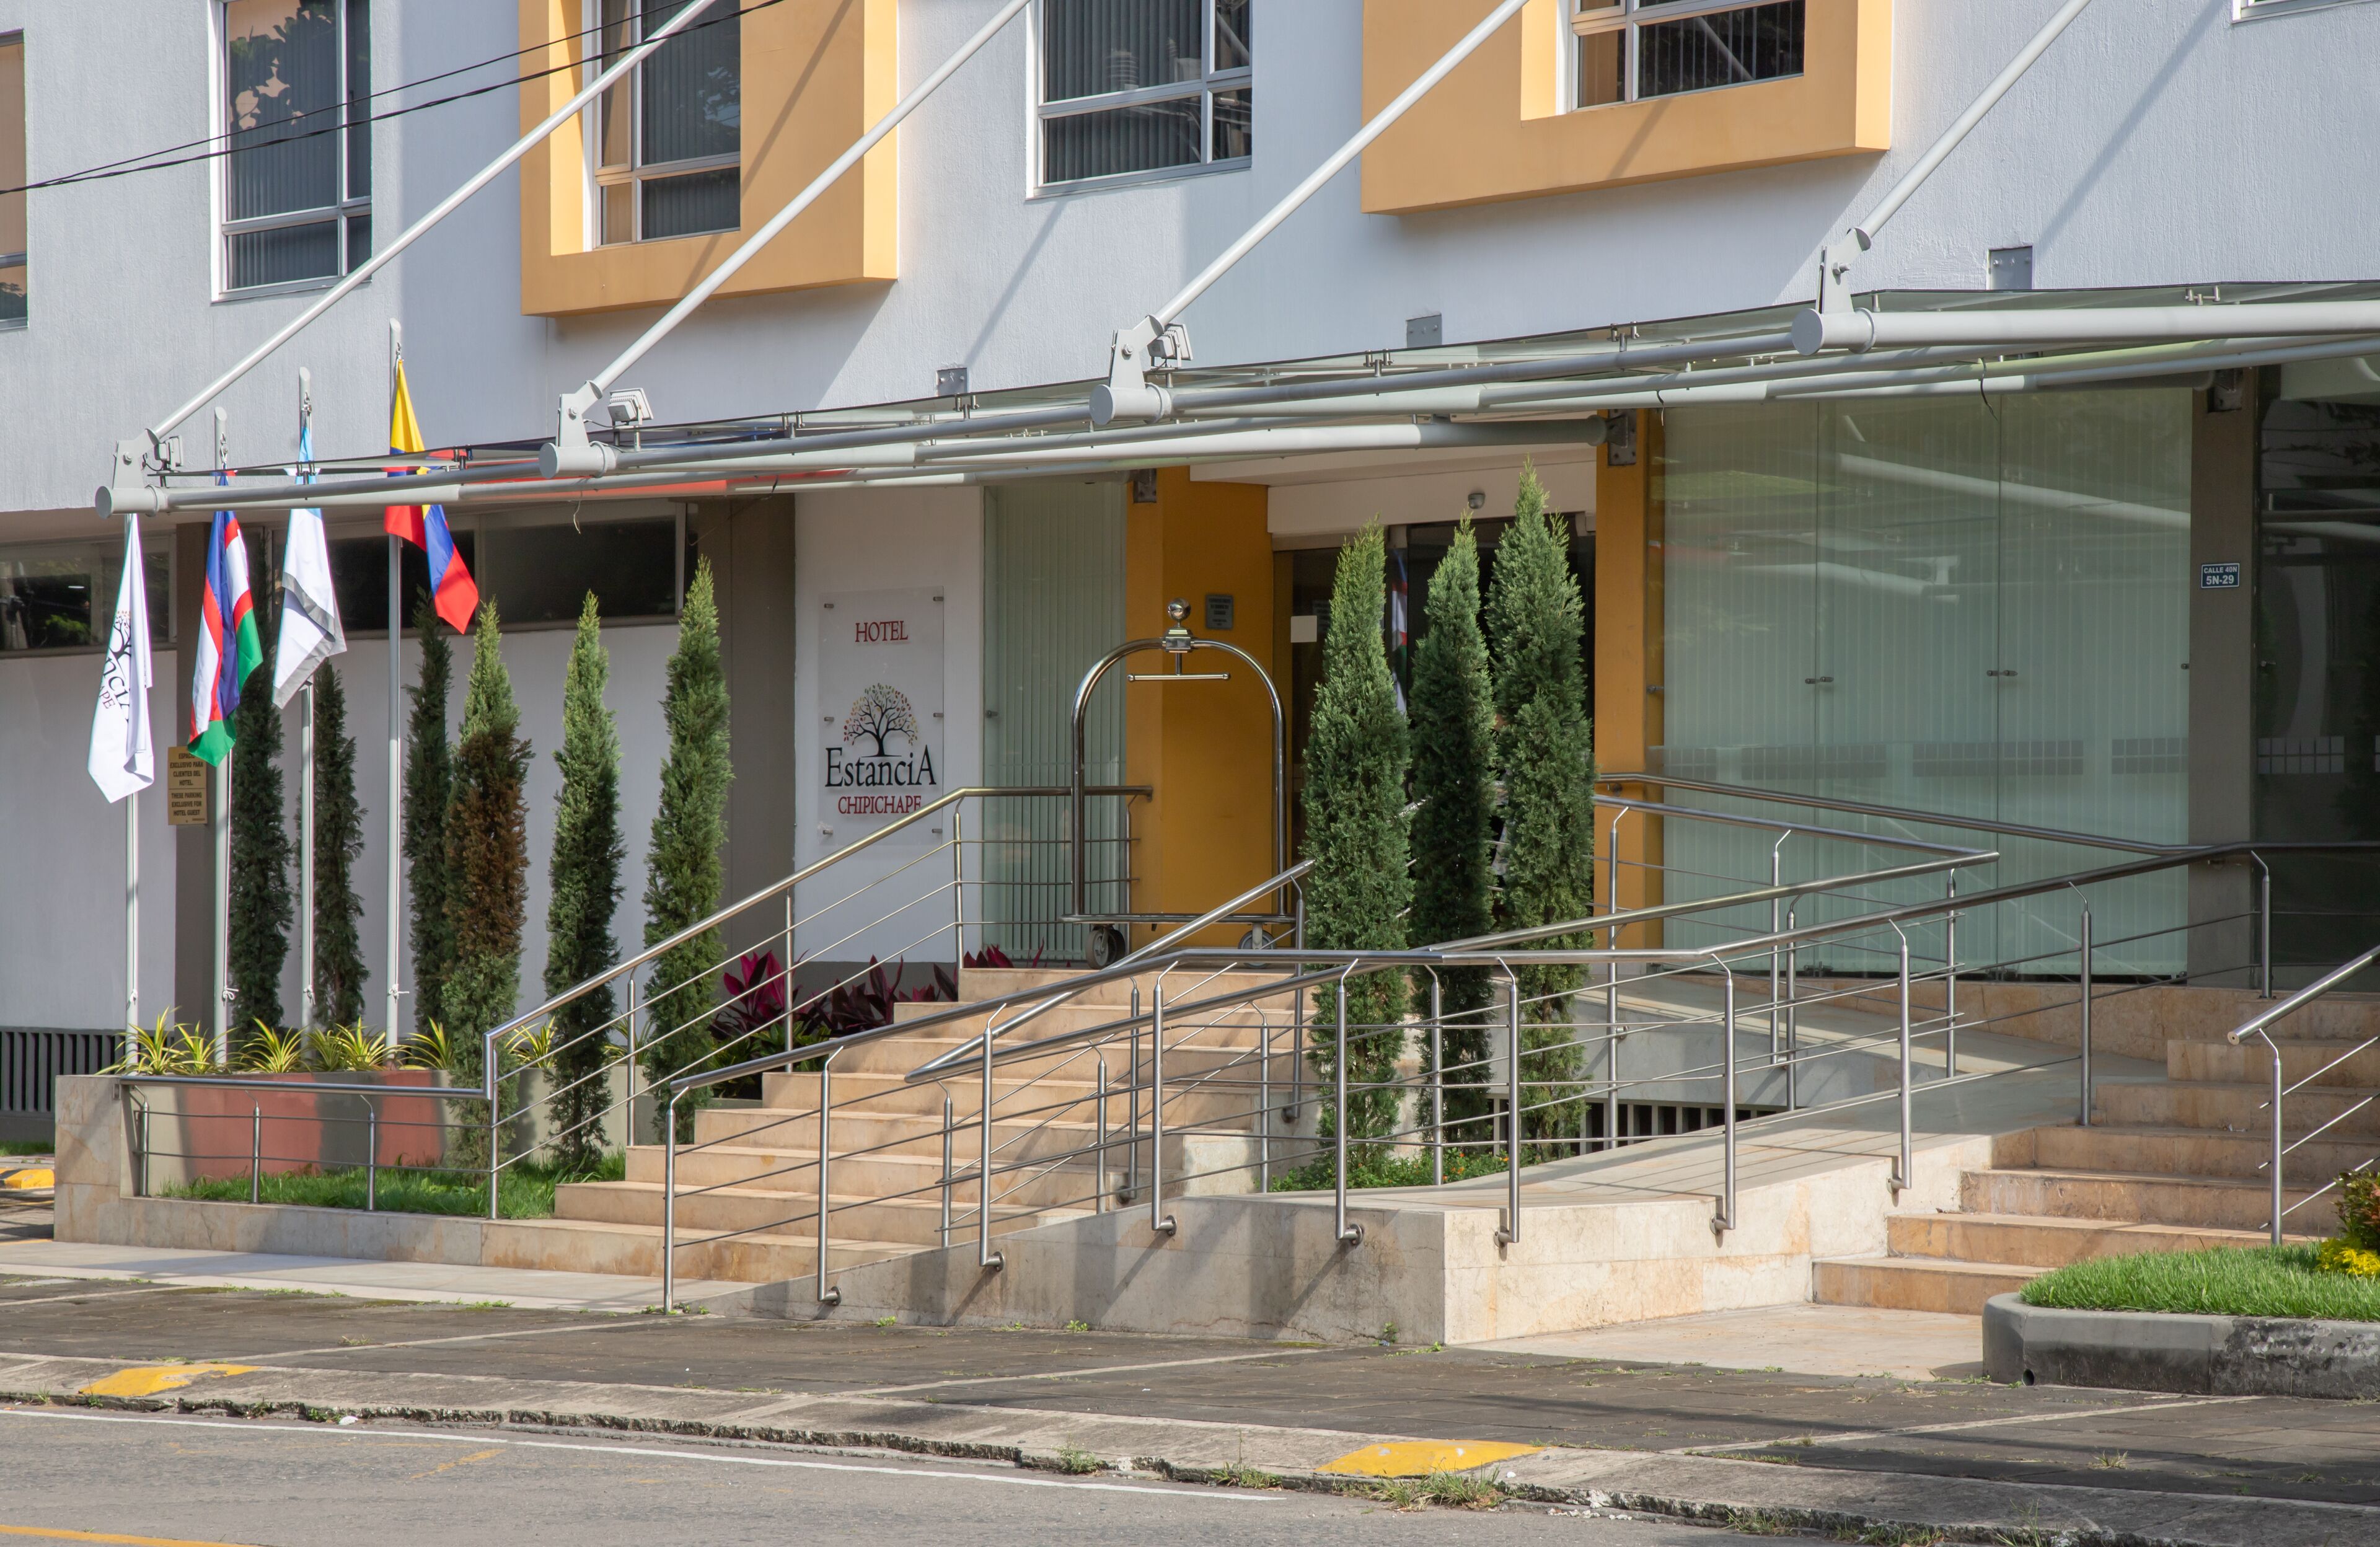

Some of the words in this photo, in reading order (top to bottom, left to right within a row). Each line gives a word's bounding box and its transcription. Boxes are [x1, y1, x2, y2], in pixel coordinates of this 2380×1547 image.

[2206, 575, 2234, 585] 5N-29
[855, 620, 909, 643] HOTEL
[825, 744, 937, 788] EstanciA
[838, 795, 922, 814] CHIPICHAPE
